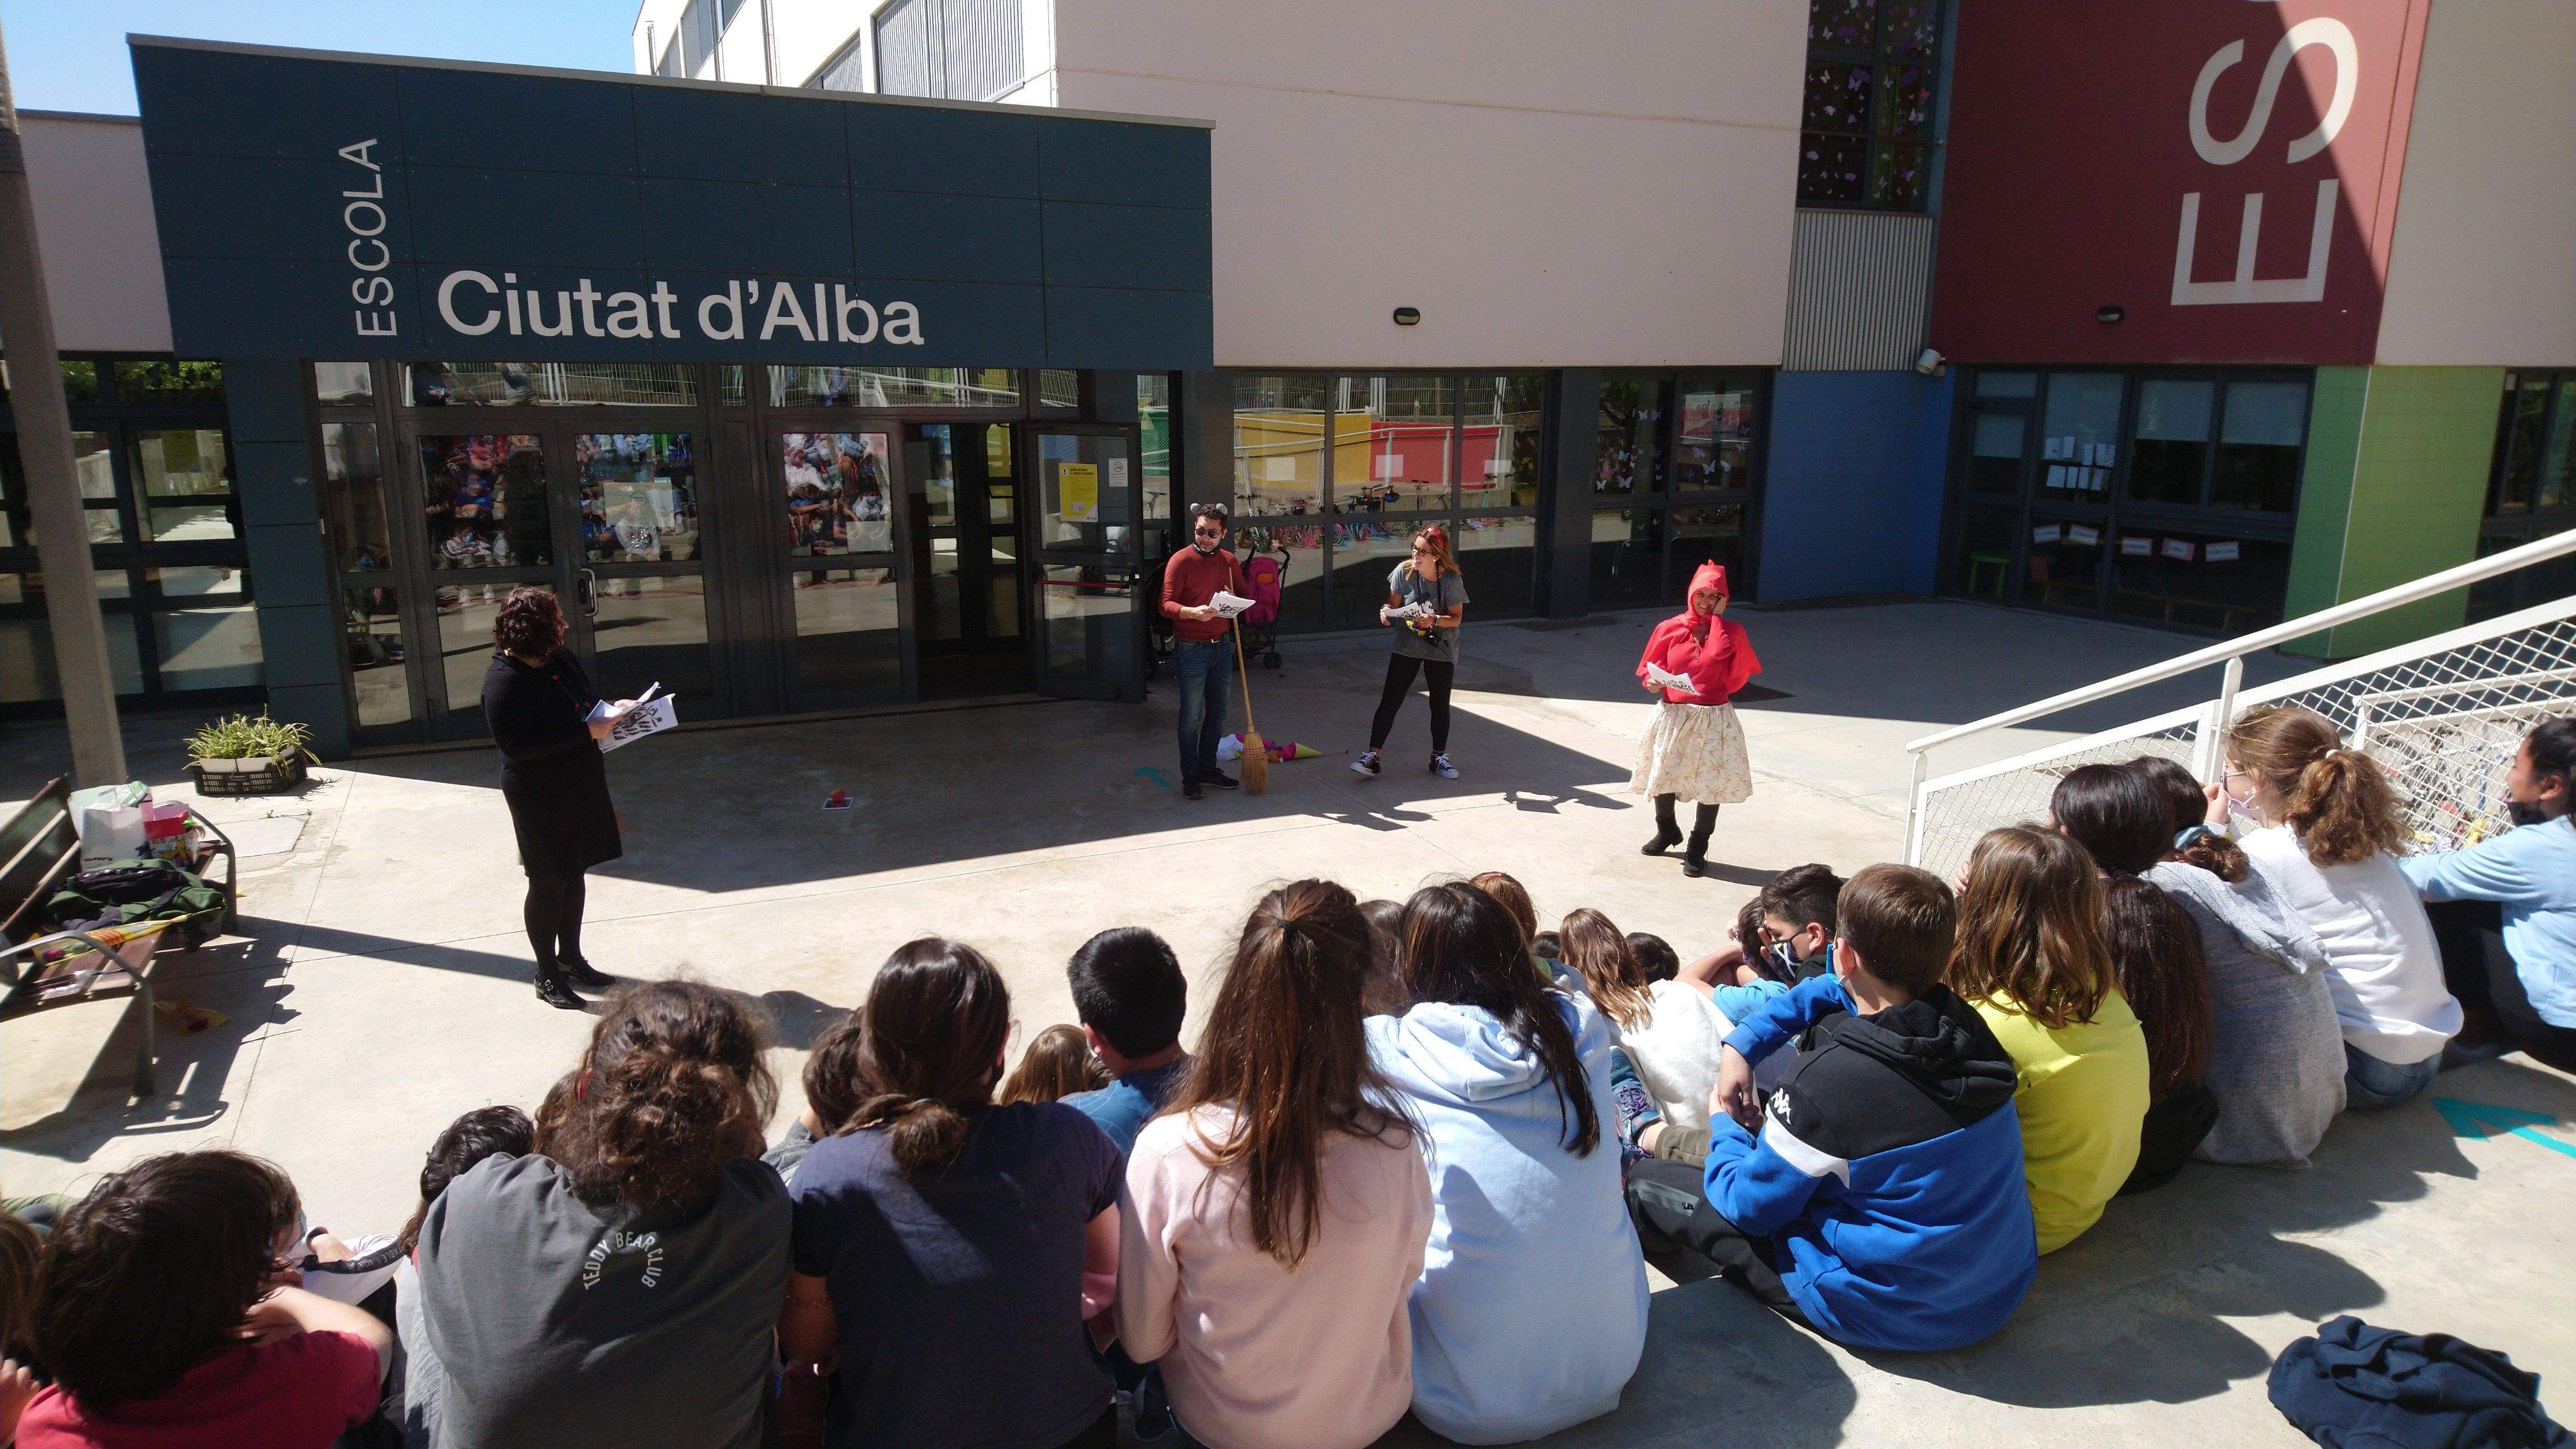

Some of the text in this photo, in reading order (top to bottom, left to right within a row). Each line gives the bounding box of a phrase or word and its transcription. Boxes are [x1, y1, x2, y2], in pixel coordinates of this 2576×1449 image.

[2171, 0, 2358, 306] ES
[338, 138, 397, 336] ESCOLA
[438, 270, 924, 345] Ciutat d'Alba
[582, 1231, 663, 1290] TEDDY BEAR CLUB
